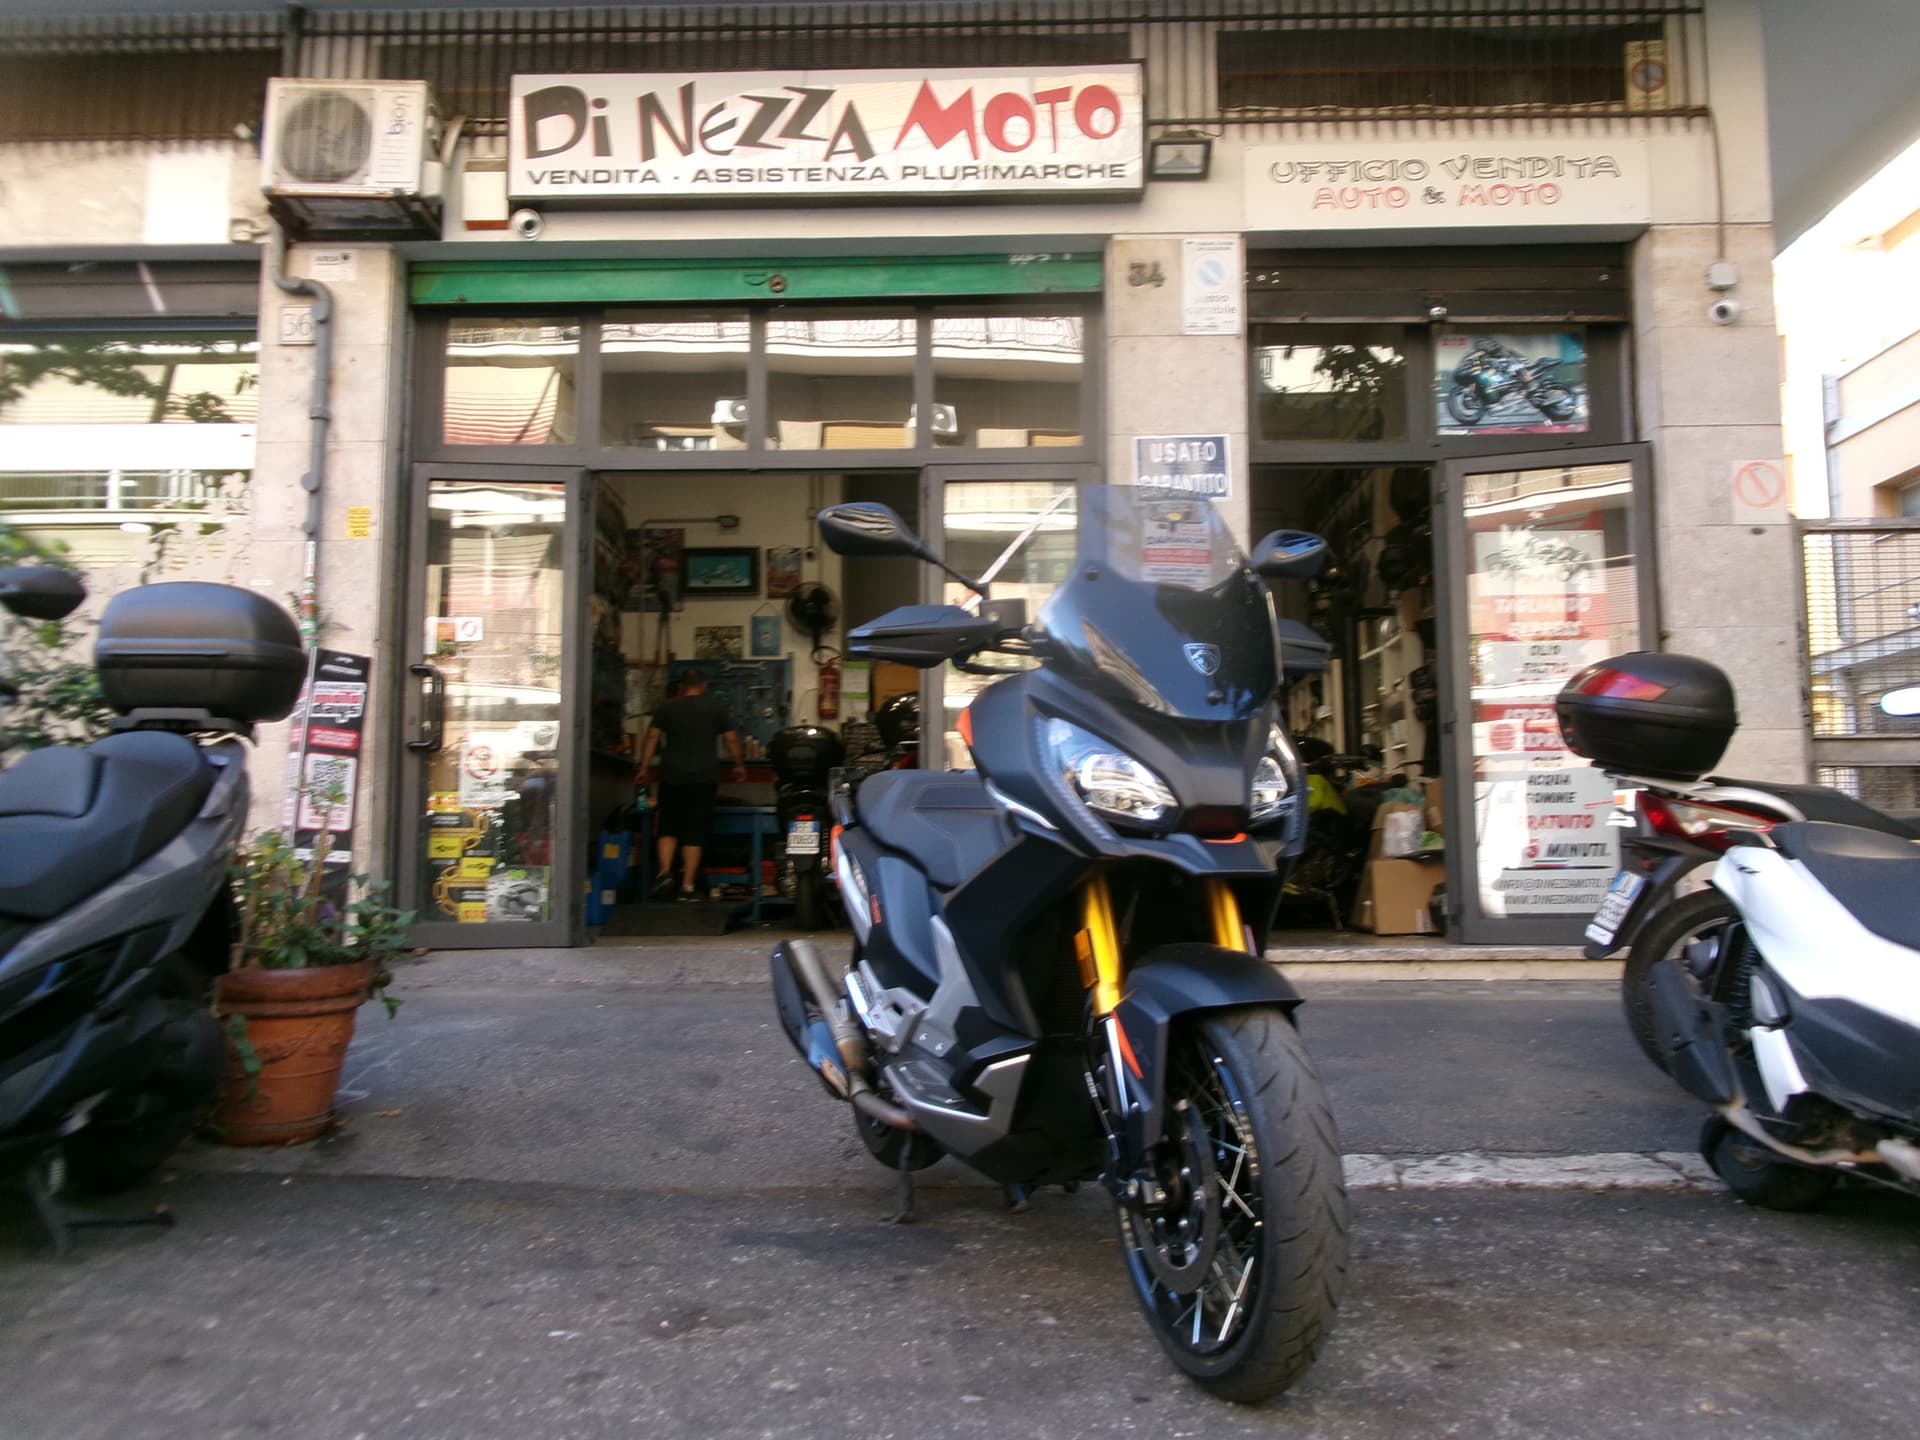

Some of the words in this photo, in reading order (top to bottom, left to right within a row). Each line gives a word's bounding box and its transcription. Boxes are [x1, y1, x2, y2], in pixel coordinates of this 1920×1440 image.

[522, 85, 613, 160] Di
[893, 78, 1123, 161] MOTO
[527, 168, 658, 185] VENDITA
[691, 165, 889, 184] ASSISTENZA
[901, 163, 1127, 181] PLURIMARCHE
[1268, 158, 1431, 184] UFFICIO
[1439, 154, 1622, 181] VENDITA
[1312, 184, 1410, 210] AUTO
[1422, 186, 1446, 205] &
[1457, 182, 1562, 207] MOTO
[1150, 441, 1217, 463] USATO
[1527, 774, 1571, 786] ACQUA
[1518, 814, 1595, 831] RATUITO
